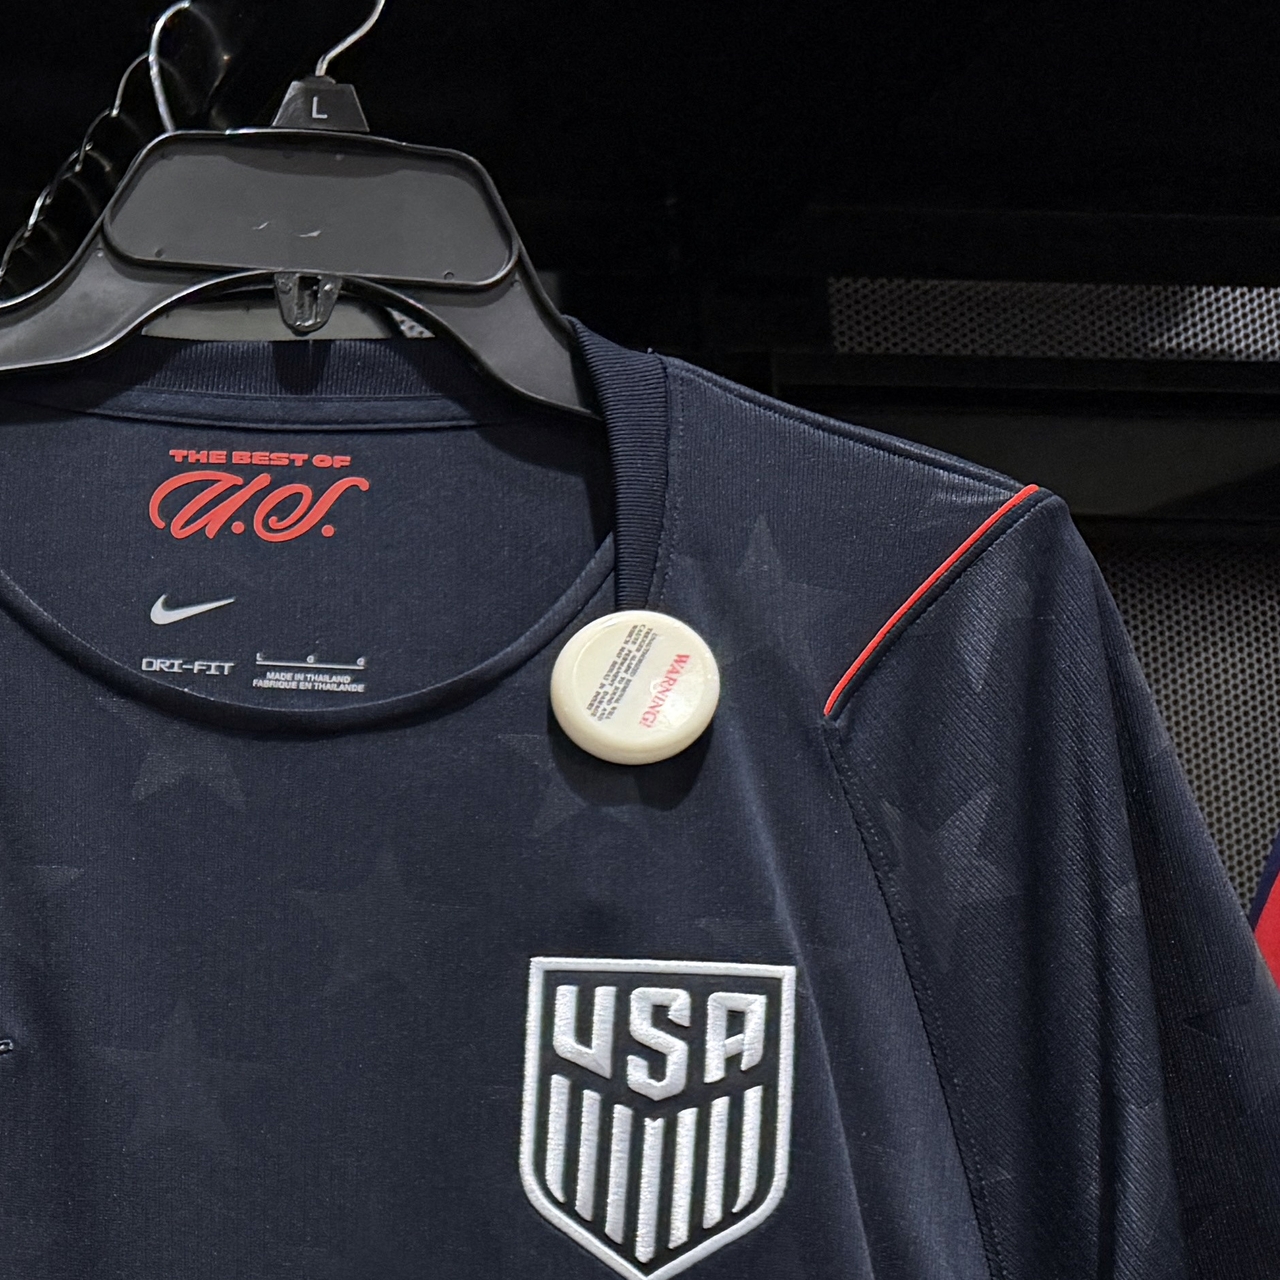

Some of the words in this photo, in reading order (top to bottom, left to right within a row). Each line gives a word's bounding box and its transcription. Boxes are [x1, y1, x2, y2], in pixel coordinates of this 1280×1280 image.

[312, 96, 328, 119] L
[169, 449, 227, 464] THE
[232, 451, 308, 467] BEST
[312, 454, 351, 468] OF
[149, 470, 370, 543] U.S.
[141, 657, 235, 675] DRI-FIT
[252, 679, 298, 690] FABRIQUE
[299, 681, 312, 690] EN
[313, 682, 365, 693] THAILANDE
[266, 671, 293, 681] MADE
[294, 673, 305, 681] IN
[306, 673, 351, 684] THAILAND
[638, 652, 691, 727] WARNING!
[552, 984, 767, 1101] USA
